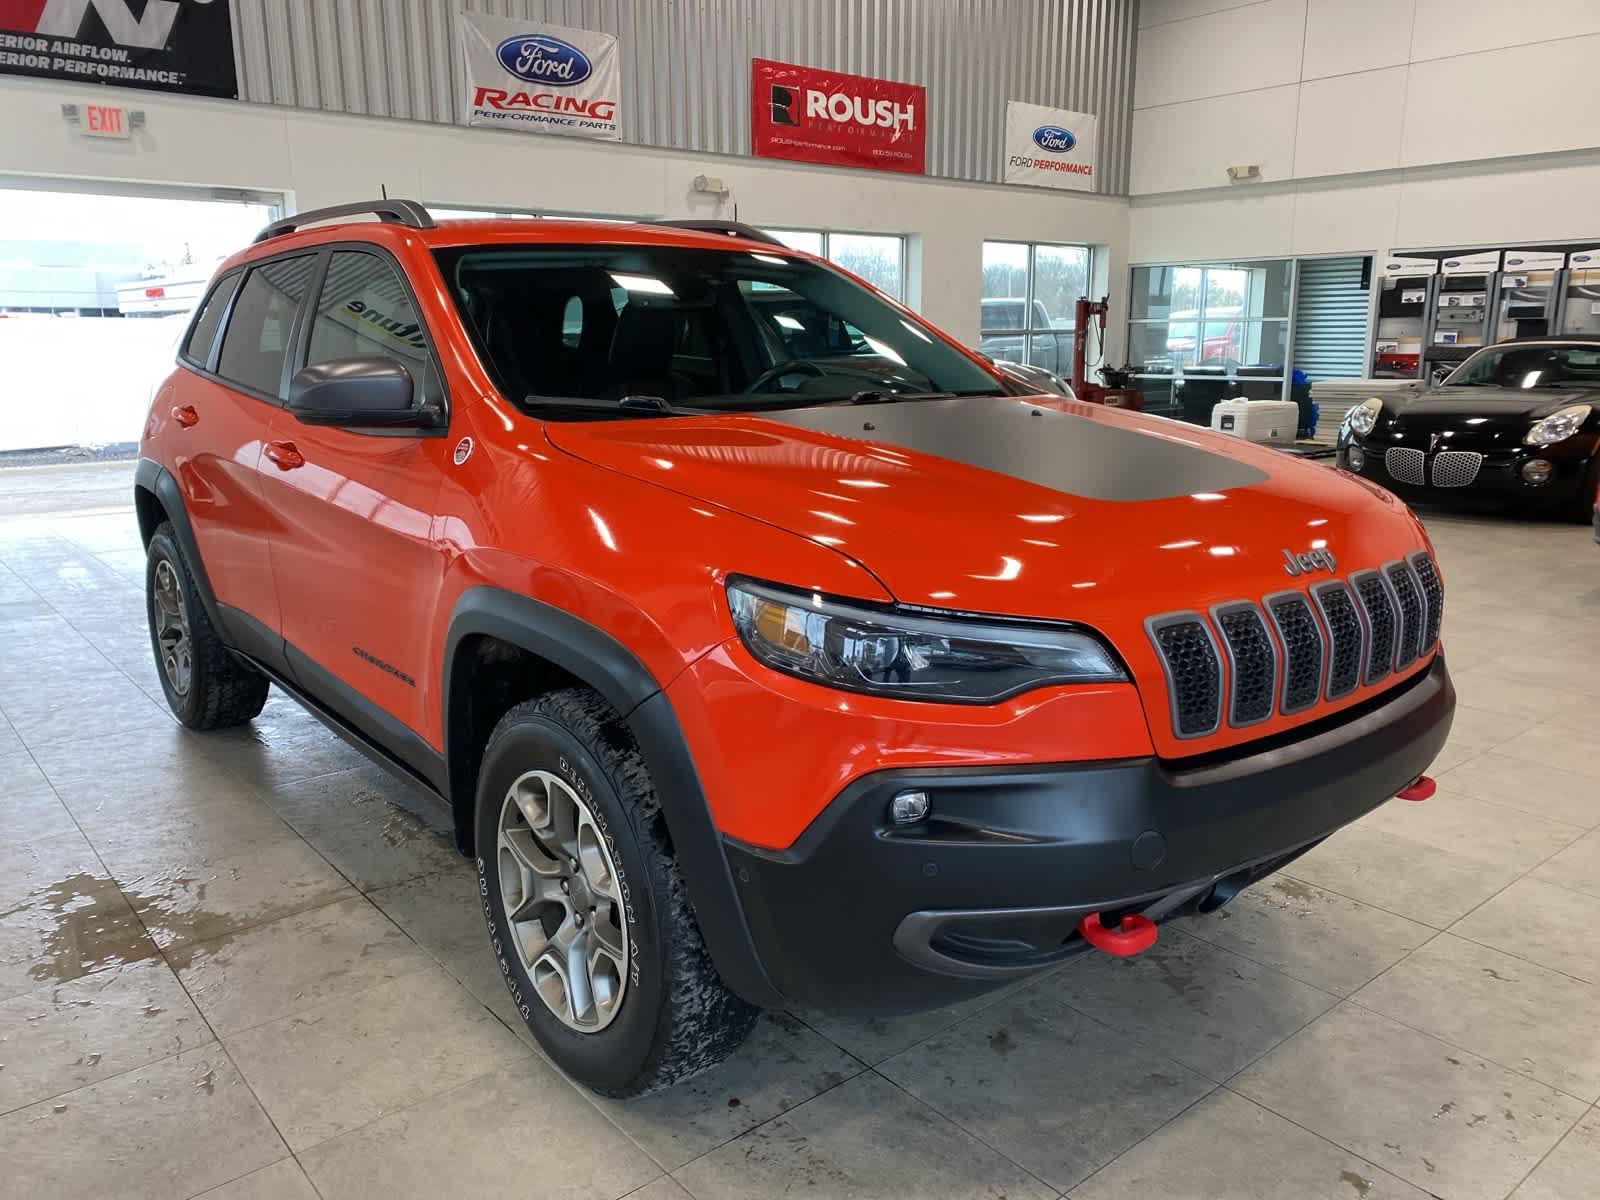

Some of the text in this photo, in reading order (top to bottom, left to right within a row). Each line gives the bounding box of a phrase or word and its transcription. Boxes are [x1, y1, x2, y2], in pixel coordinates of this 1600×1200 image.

[51, 40, 132, 63] AIRFLOW.
[515, 41, 575, 80] Ford
[473, 86, 616, 121] RACING
[806, 89, 914, 131] ROUSH
[87, 105, 122, 133] EXIT
[473, 109, 616, 131] PERFORMANCE PARTS
[1041, 129, 1068, 149] Ford
[1009, 156, 1093, 175] FORD PERFORMANCE
[1281, 548, 1336, 576] Jeep
